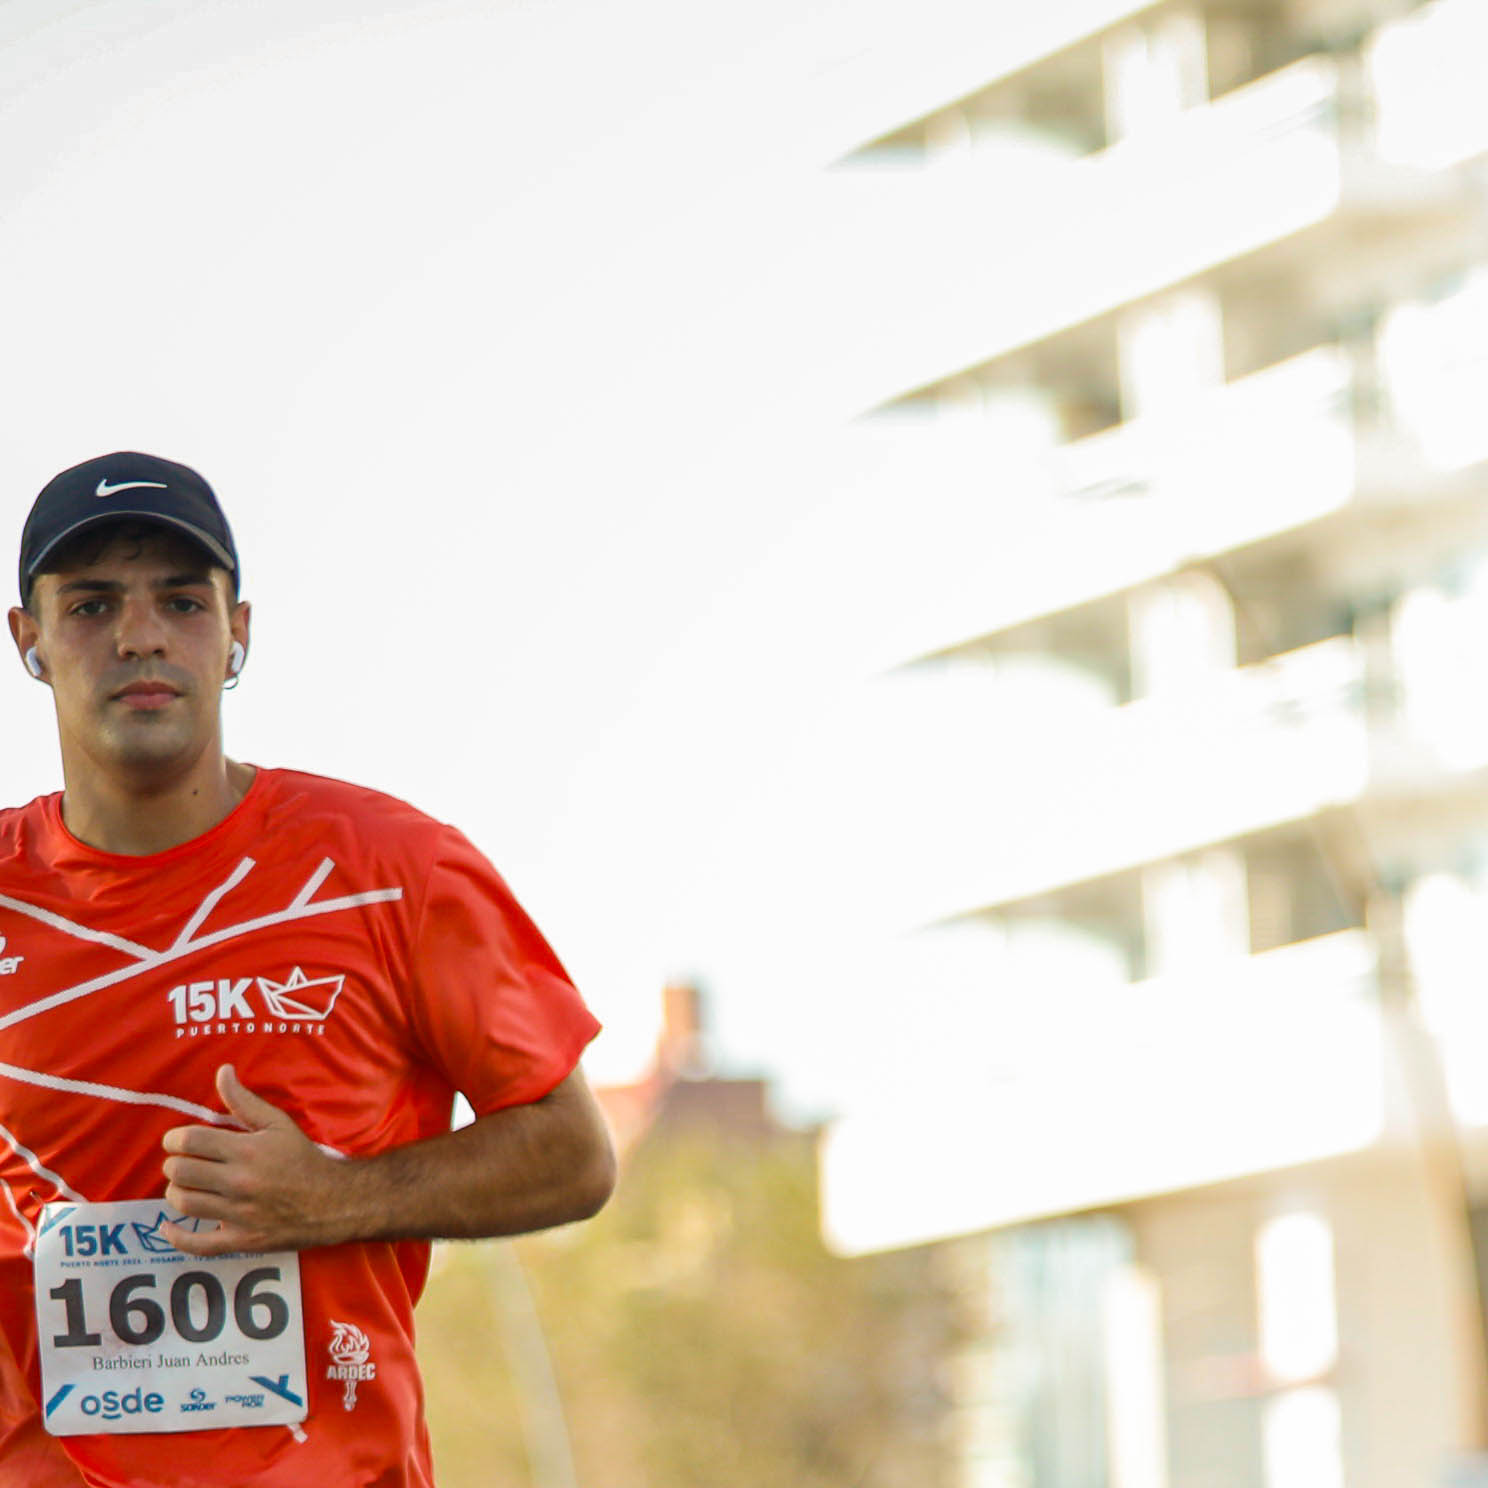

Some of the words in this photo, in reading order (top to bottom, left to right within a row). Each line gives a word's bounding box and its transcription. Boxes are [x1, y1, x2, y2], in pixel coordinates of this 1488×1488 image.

[168, 977, 255, 1024] 15K
[176, 1023, 255, 1038] PUERTO
[264, 1023, 325, 1036] NORTE
[59, 1224, 128, 1257] 15K
[50, 1267, 289, 1347] 1606
[92, 1355, 152, 1371] Barbieri
[157, 1354, 190, 1369] Juan
[197, 1352, 250, 1368] Andres
[326, 1364, 376, 1380] ARDEC
[81, 1386, 165, 1418] osde
